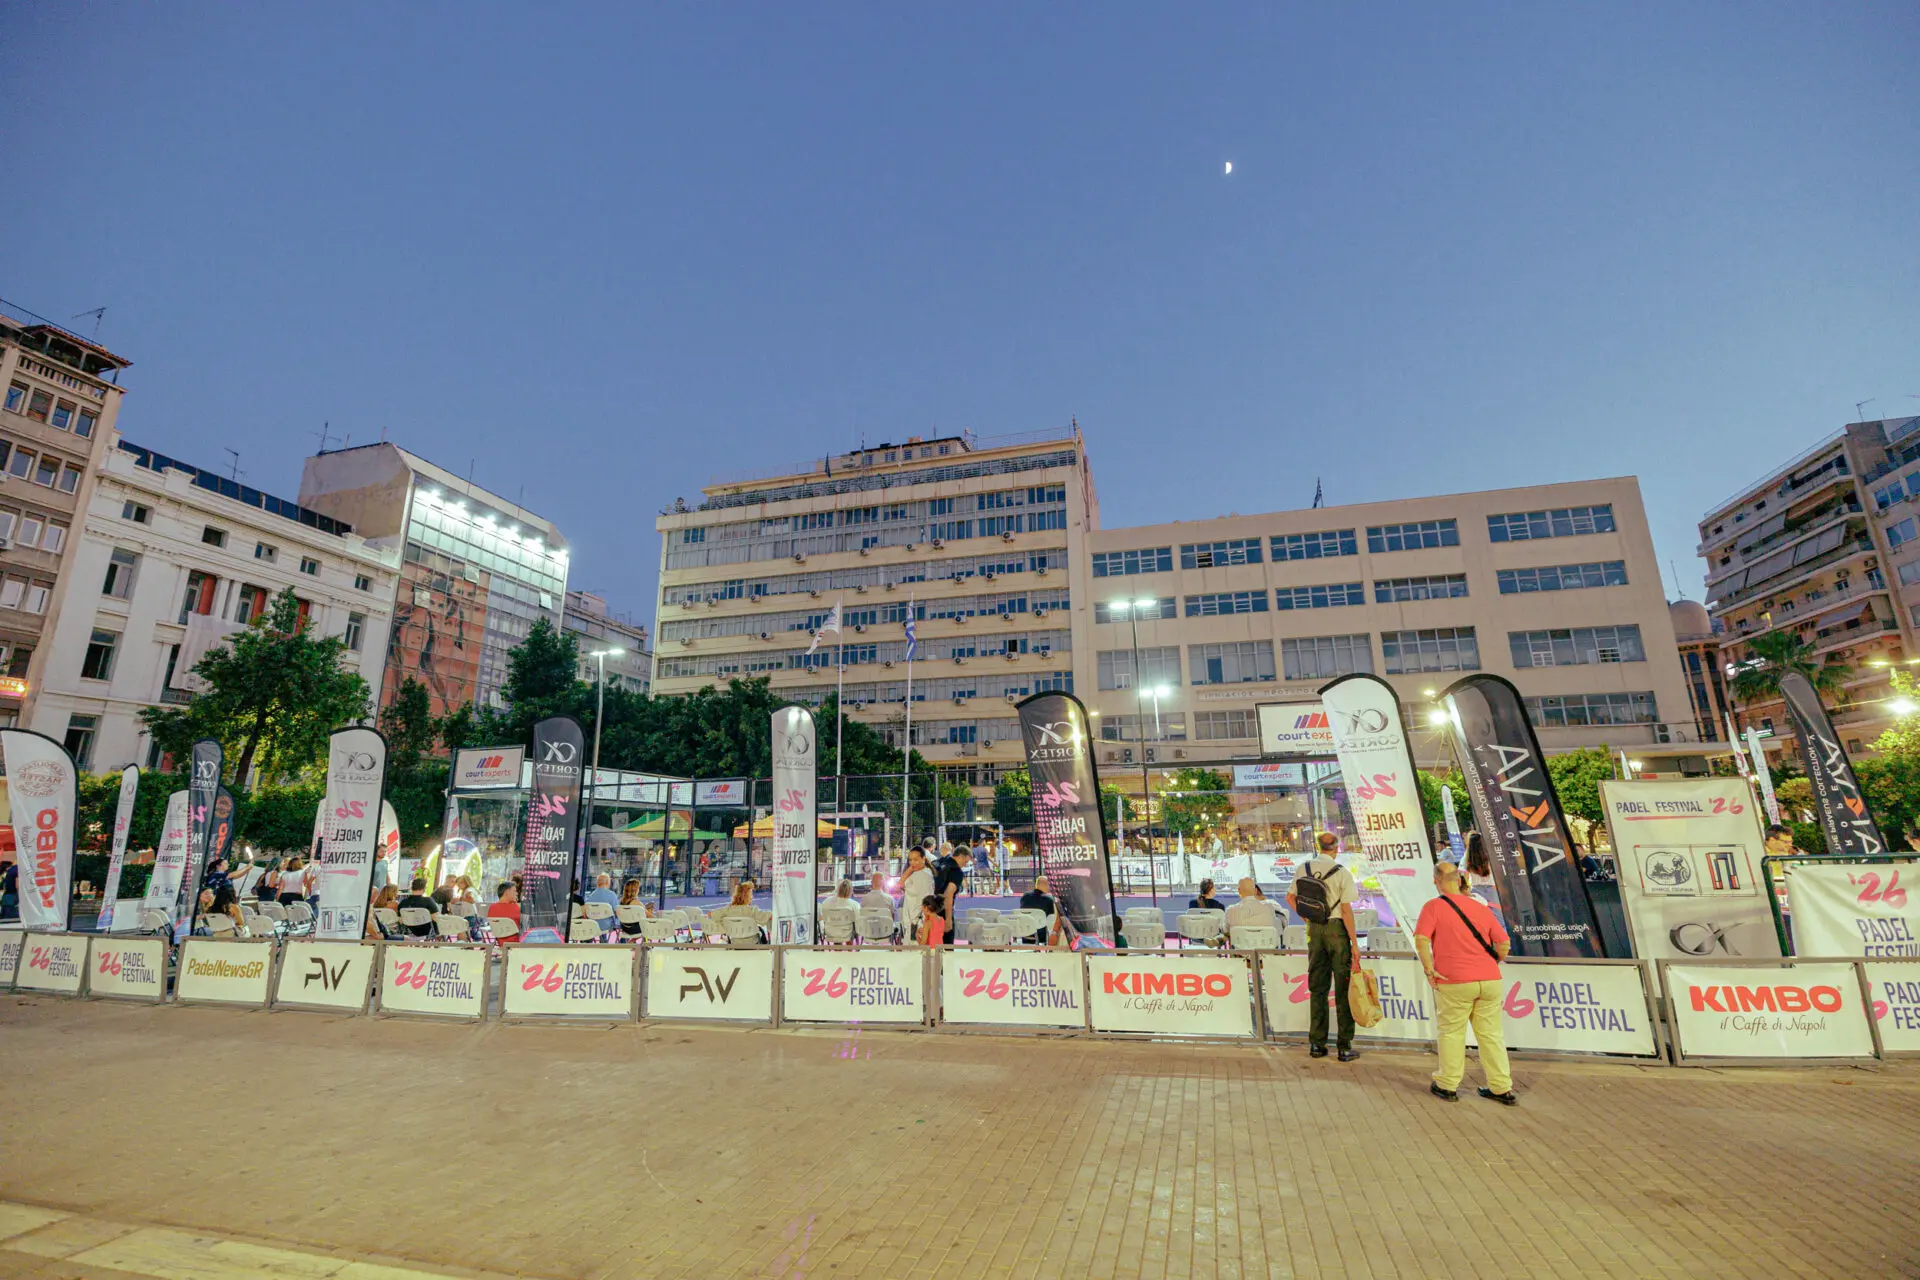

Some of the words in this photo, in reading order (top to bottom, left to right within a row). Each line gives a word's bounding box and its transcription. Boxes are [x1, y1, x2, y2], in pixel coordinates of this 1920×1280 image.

[1616, 801, 1650, 814] PADEL
[1655, 800, 1703, 813] FESTIVAL
[1708, 797, 1744, 815] '26
[1847, 870, 1907, 909] '26
[1856, 917, 1914, 943] PADEL
[1, 943, 21, 957] PADE
[30, 946, 51, 970] '26
[51, 946, 72, 962] PADEL
[122, 952, 145, 968] PADEL
[48, 962, 78, 978] FESTIVAL
[98, 951, 122, 977] '26
[187, 957, 264, 979] PadelNewsGR
[429, 961, 460, 980] PADEL
[565, 962, 604, 981] PADEL
[121, 968, 156, 984] FESTIVAL
[395, 960, 428, 989] '26
[521, 962, 564, 993] '26
[800, 967, 849, 999] '26
[850, 967, 894, 986] PADEL
[959, 967, 1010, 1001] '26
[1011, 968, 1056, 988] PADEL
[1103, 972, 1232, 997] KIMBO
[426, 980, 474, 1000] FESTIVAL
[563, 981, 621, 1000] FESTIVAL
[850, 987, 914, 1006] FESTIVAL
[1011, 989, 1079, 1009] FESTIVAL
[1535, 982, 1600, 1006] PADEL
[1689, 985, 1842, 1013] KIMBO
[1166, 998, 1178, 1011] di
[1180, 999, 1214, 1015] Napoli
[1539, 1006, 1636, 1033] FESTIVAL
[1772, 1016, 1783, 1031] di
[1785, 1016, 1826, 1036] Napoli
